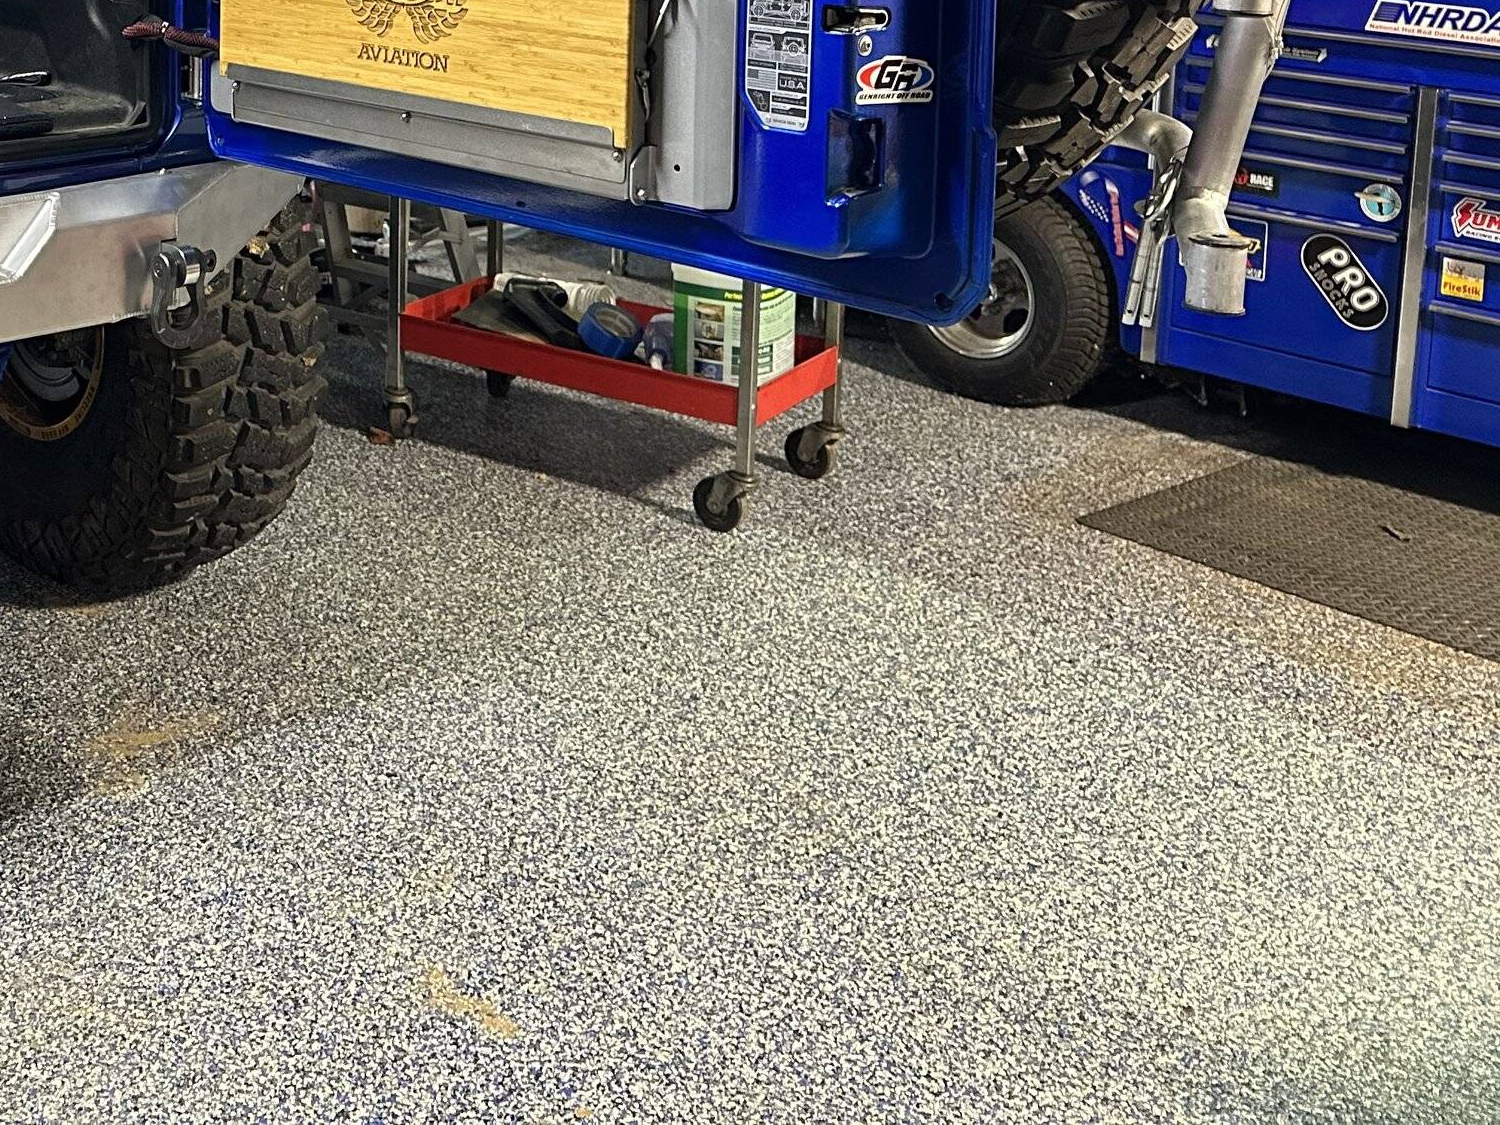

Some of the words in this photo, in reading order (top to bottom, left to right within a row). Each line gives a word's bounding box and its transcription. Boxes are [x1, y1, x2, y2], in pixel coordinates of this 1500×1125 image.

[1369, 23, 1399, 32] National
[357, 42, 449, 73] AVIATION
[1249, 173, 1274, 188] RACE
[1309, 262, 1355, 319] SHOCKS
[1317, 246, 1380, 312] PRO
